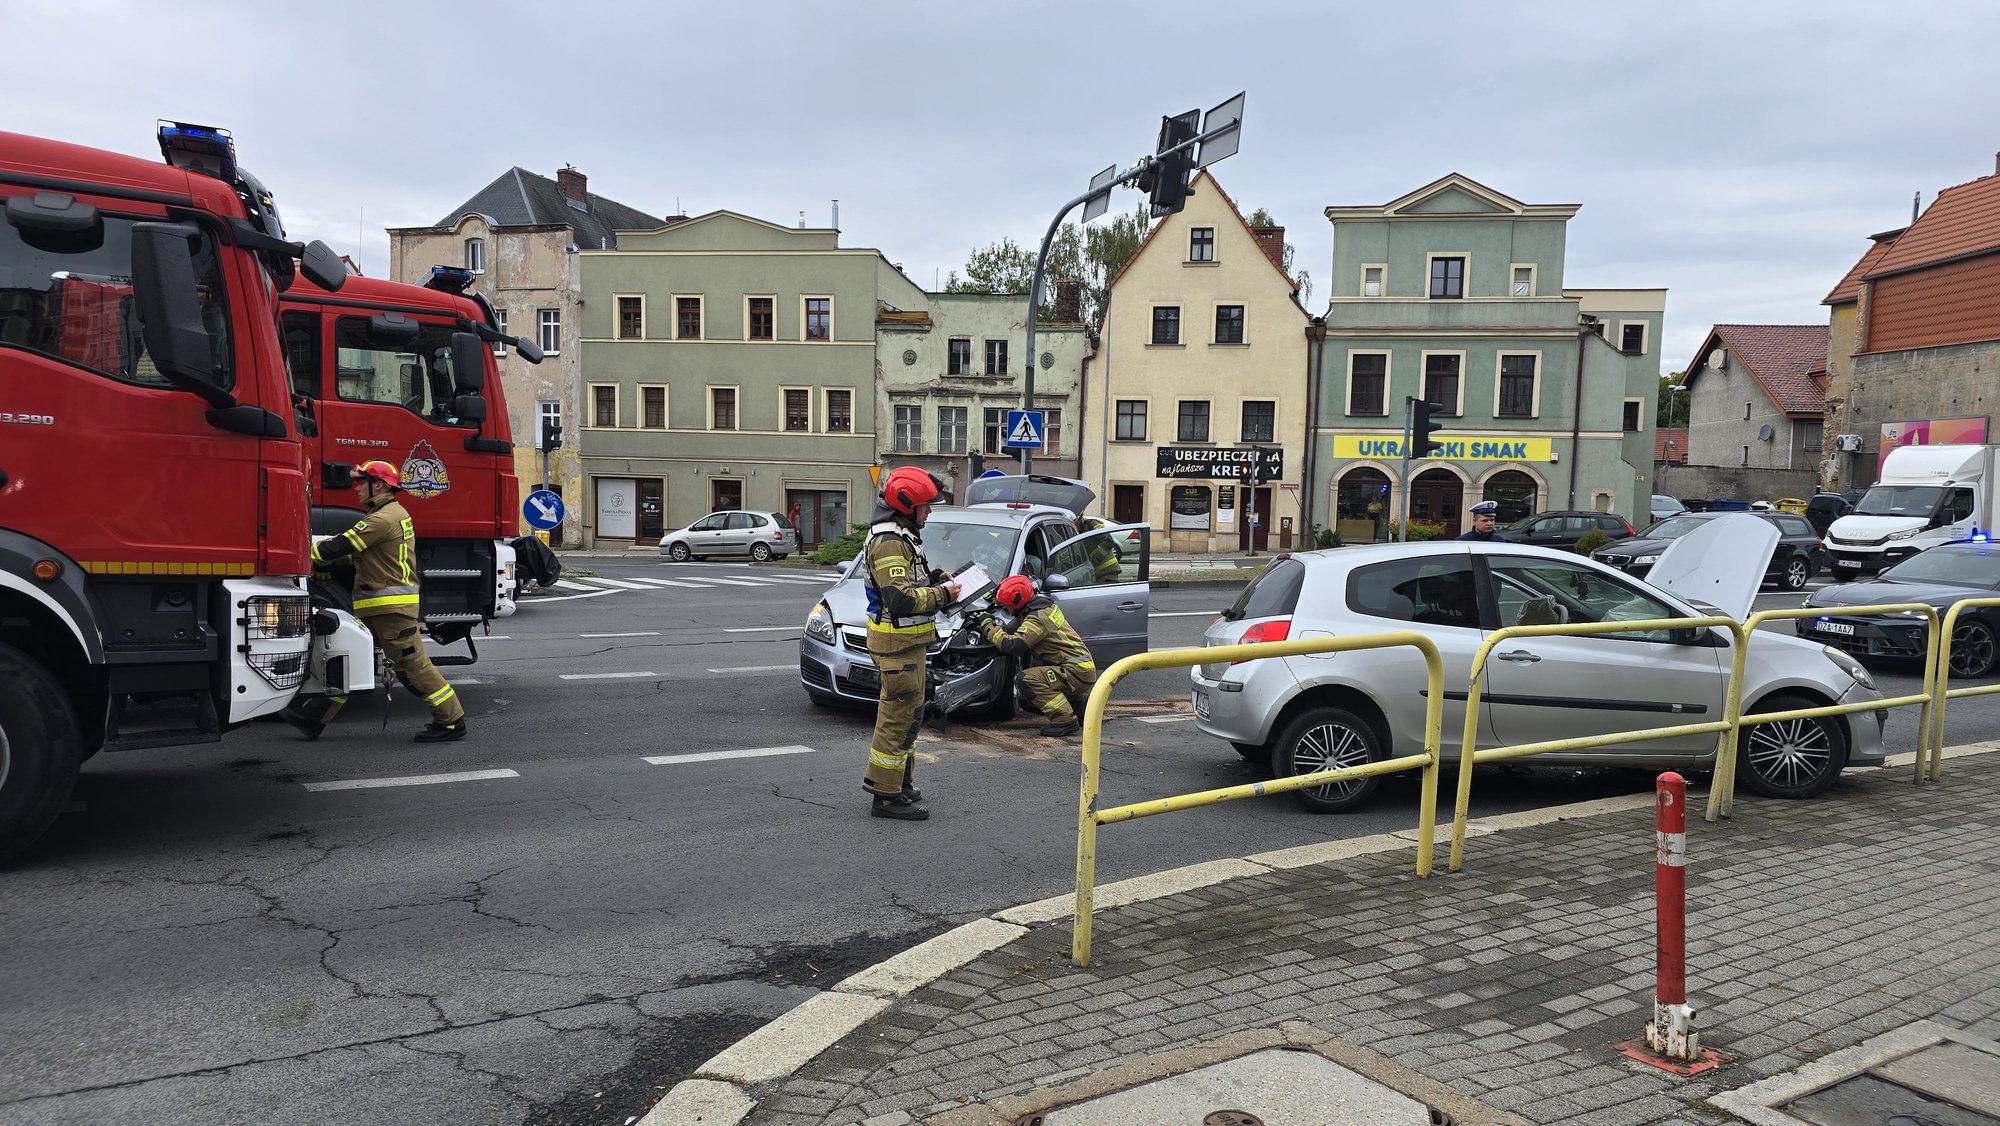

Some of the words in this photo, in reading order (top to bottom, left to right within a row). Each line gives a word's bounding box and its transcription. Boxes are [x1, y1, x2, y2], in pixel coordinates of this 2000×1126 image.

[0, 413, 55, 425] 3.290
[336, 438, 356, 446] TGM
[356, 439, 389, 447] 18.320
[1358, 440, 1465, 458] UKRASKI
[1470, 442, 1527, 459] SMAK
[1161, 463, 1205, 477] najtańsze
[1211, 465, 1280, 477] KREYY
[891, 567, 904, 575] PSP
